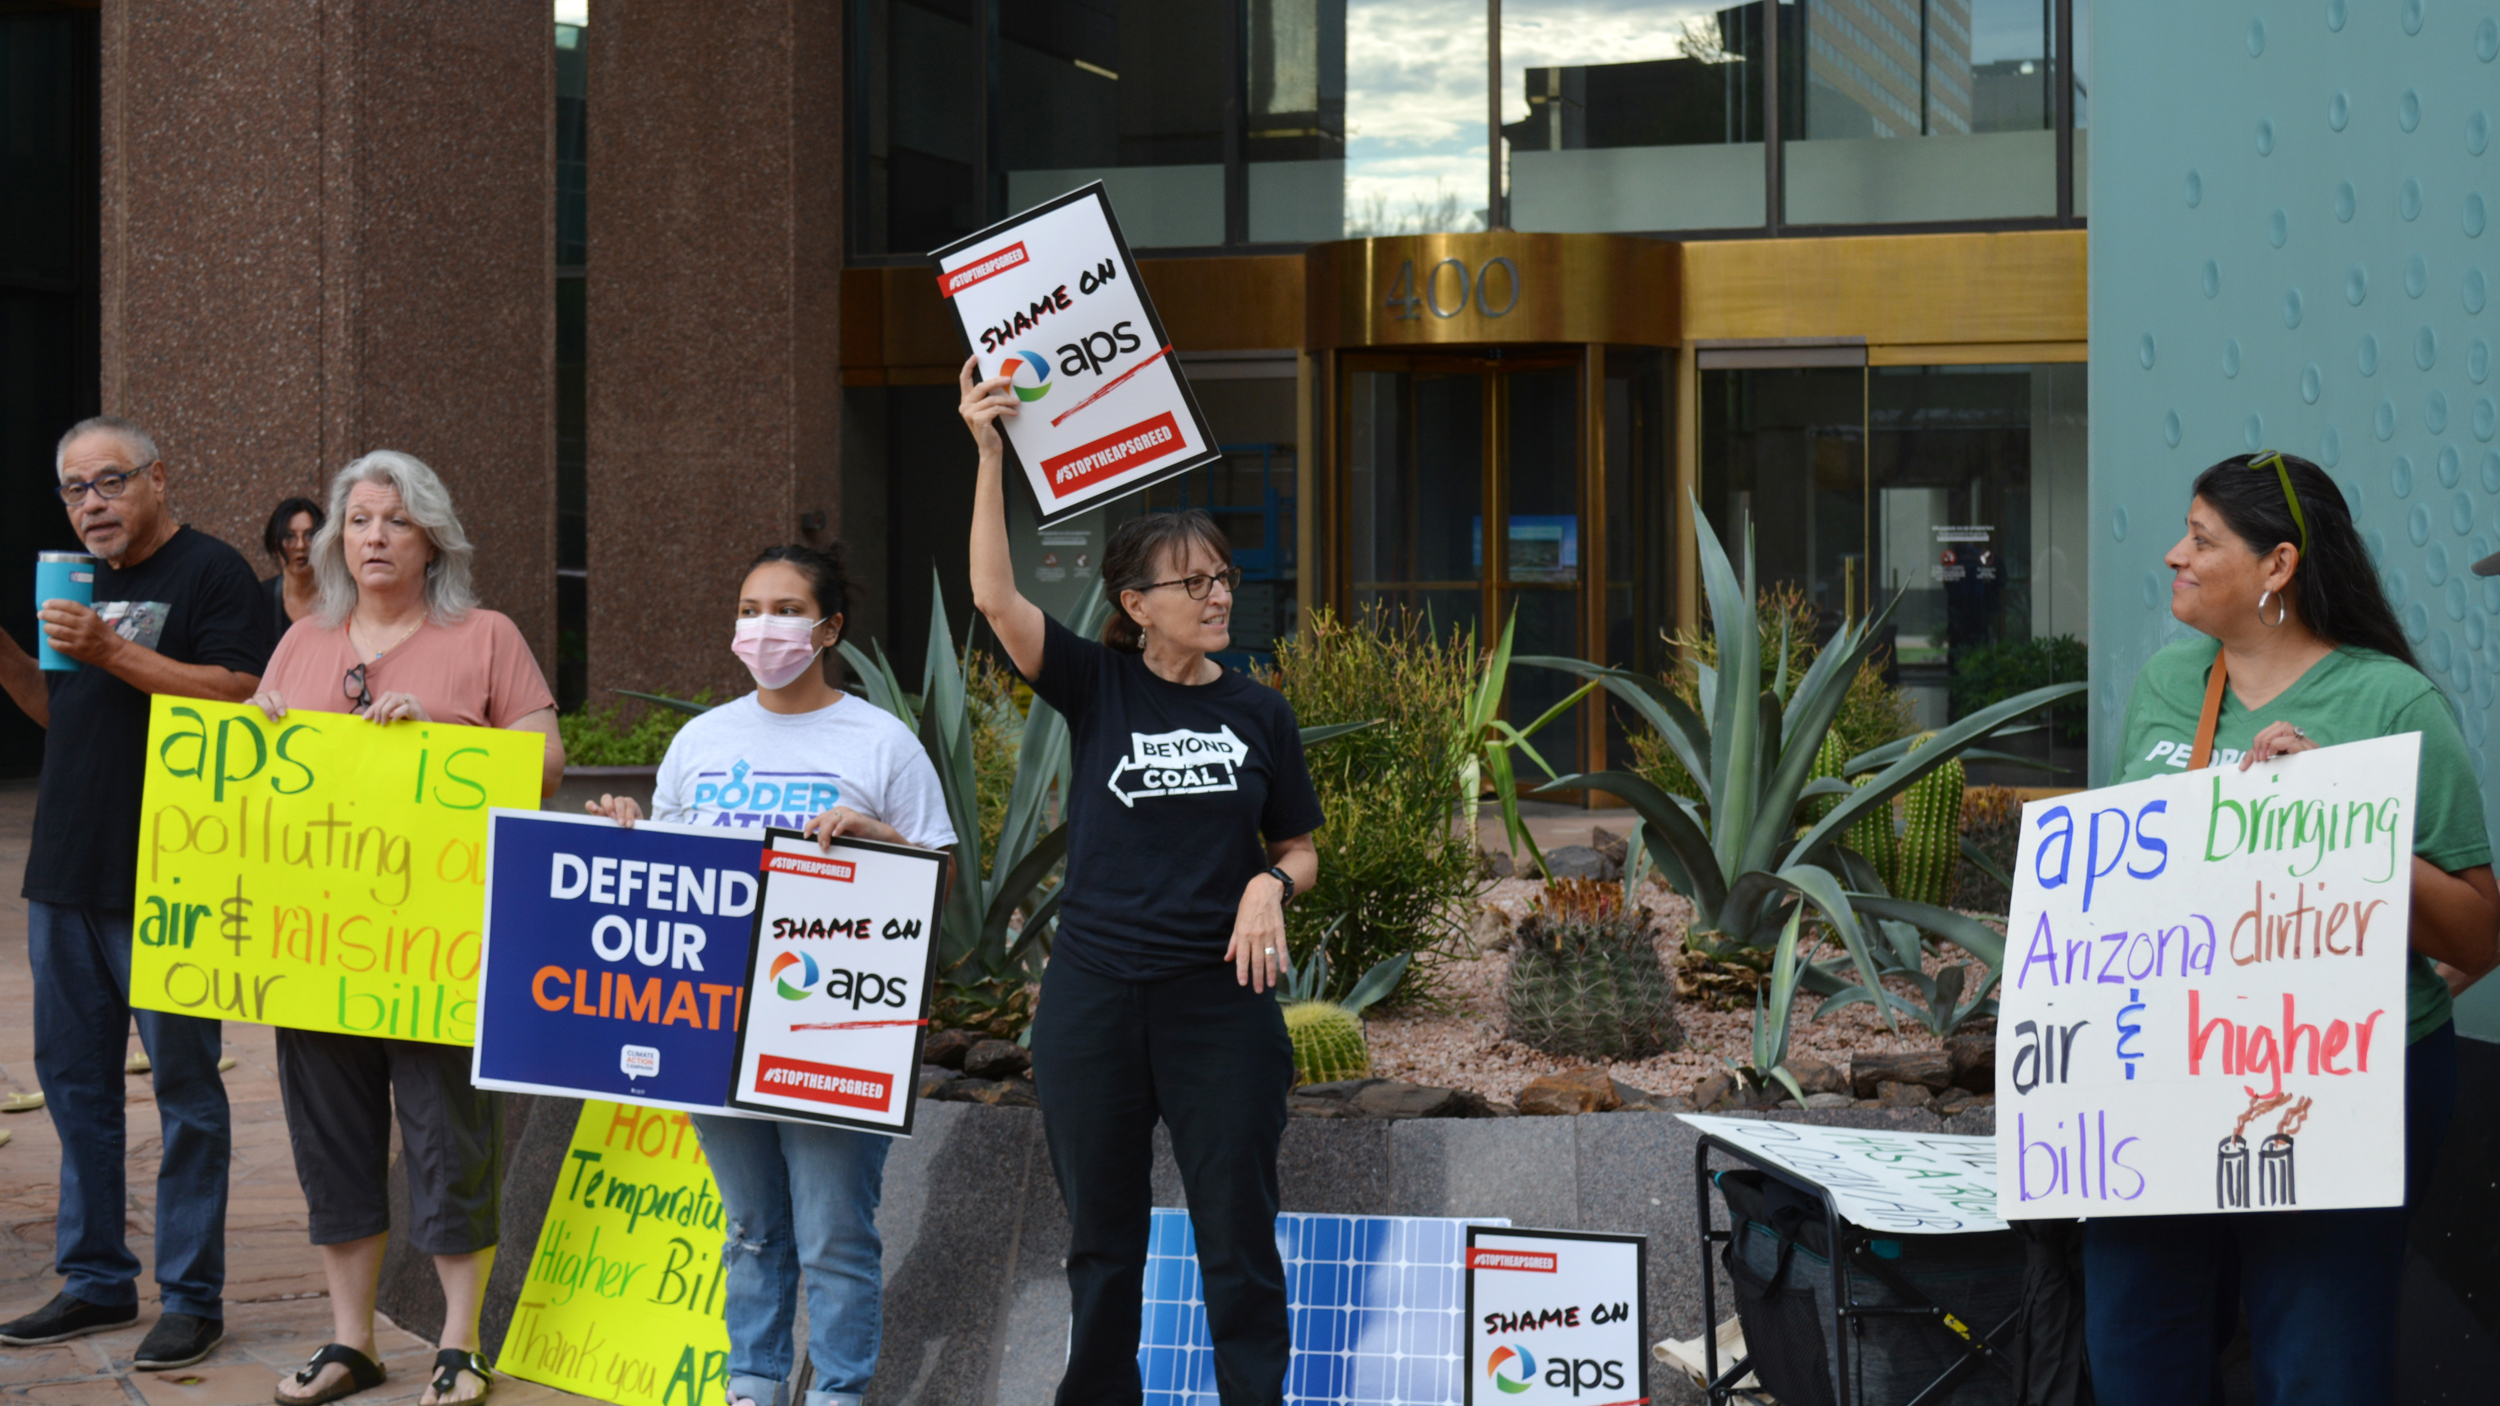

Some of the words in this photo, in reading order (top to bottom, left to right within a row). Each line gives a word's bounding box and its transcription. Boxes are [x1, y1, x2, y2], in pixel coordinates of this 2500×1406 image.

[949, 248, 1024, 291] #STOPTHEAPSGREED
[1384, 256, 1520, 320] 400
[980, 285, 1073, 353] SHAME
[1079, 258, 1117, 295] ON
[1056, 321, 1141, 376] aps
[1055, 425, 1173, 484] #STOPTHEAPSGREED
[160, 707, 322, 802] aps
[415, 731, 490, 810] is
[1142, 737, 1234, 758] BEYOND
[691, 781, 840, 812] PODER
[1143, 766, 1219, 789] COAL
[152, 796, 411, 906] polluting
[769, 857, 852, 879] #STOPTHEAPSGREED
[2035, 800, 2168, 913] aps
[2203, 774, 2400, 883] bringing
[139, 877, 213, 949] air
[550, 852, 759, 918] DEFEND
[591, 914, 707, 972] OUR
[772, 917, 872, 940] SHAME
[882, 918, 922, 940] ON
[2018, 910, 2217, 989] Arizona
[2229, 880, 2389, 967] dirtier
[165, 962, 288, 1020] our
[826, 968, 908, 1010] aps
[2011, 1001, 2092, 1095] air
[2187, 989, 2386, 1099] higher
[764, 1067, 884, 1099] #STOPTHEAPSGREED
[2018, 1110, 2146, 1202] bills
[569, 1149, 728, 1235] Temperatu
[534, 1219, 647, 1306] Higher
[647, 1237, 727, 1321] Bil
[1473, 1253, 1555, 1271] #STOPTHEAPSGREED
[1484, 1306, 1580, 1335] SHAME
[1591, 1302, 1630, 1324] ON
[510, 1302, 606, 1383] Thank
[607, 1352, 656, 1401] you
[1544, 1356, 1625, 1398] aps
